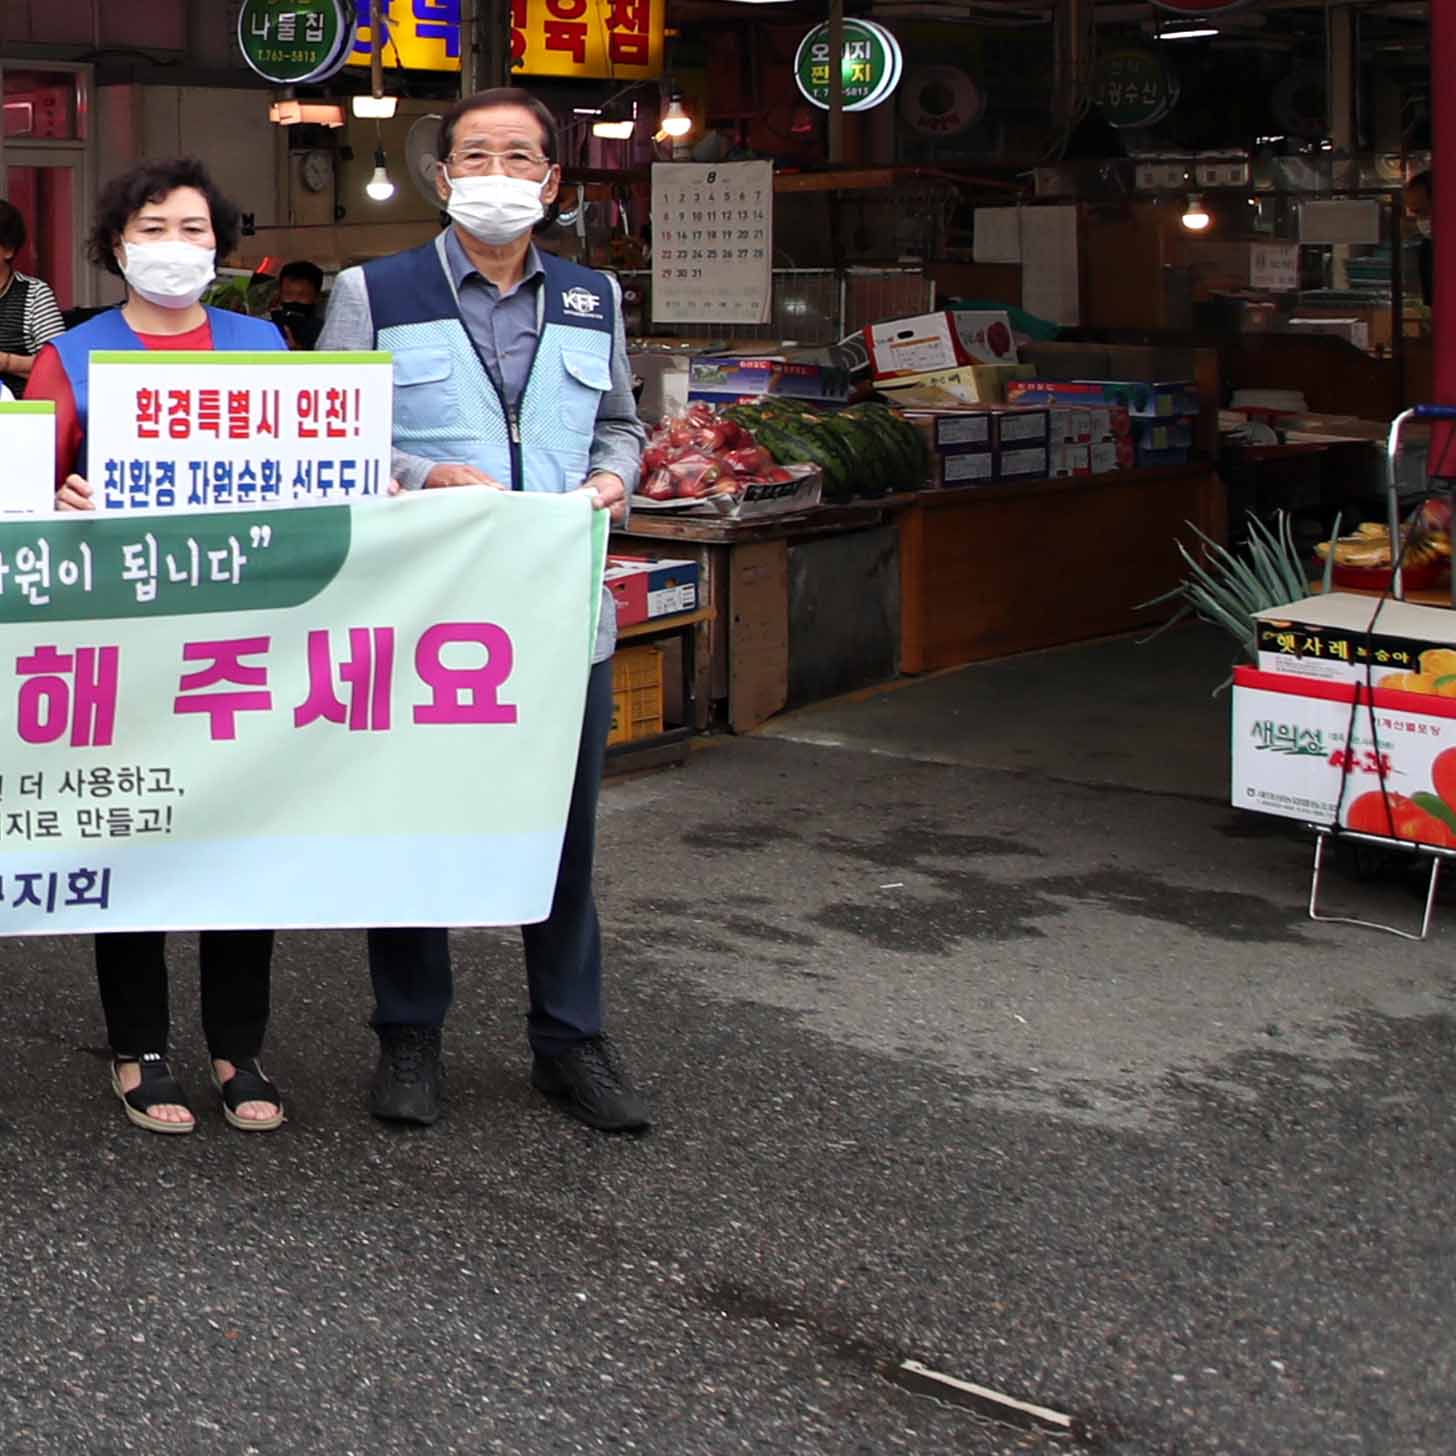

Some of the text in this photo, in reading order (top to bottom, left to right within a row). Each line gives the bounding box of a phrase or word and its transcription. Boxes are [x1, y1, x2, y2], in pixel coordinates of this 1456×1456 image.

[250, 10, 325, 43] 나물집
[706, 171, 717, 184] 8
[135, 387, 361, 440] 환경특별시 인천!
[103, 458, 176, 511] 친환경
[188, 459, 284, 506] 자원순환
[122, 524, 274, 602] 됩니다”
[172, 621, 519, 741] 주세요
[18, 771, 47, 802] 더
[58, 766, 187, 802] 사용하고,
[76, 806, 174, 839] 만들고!
